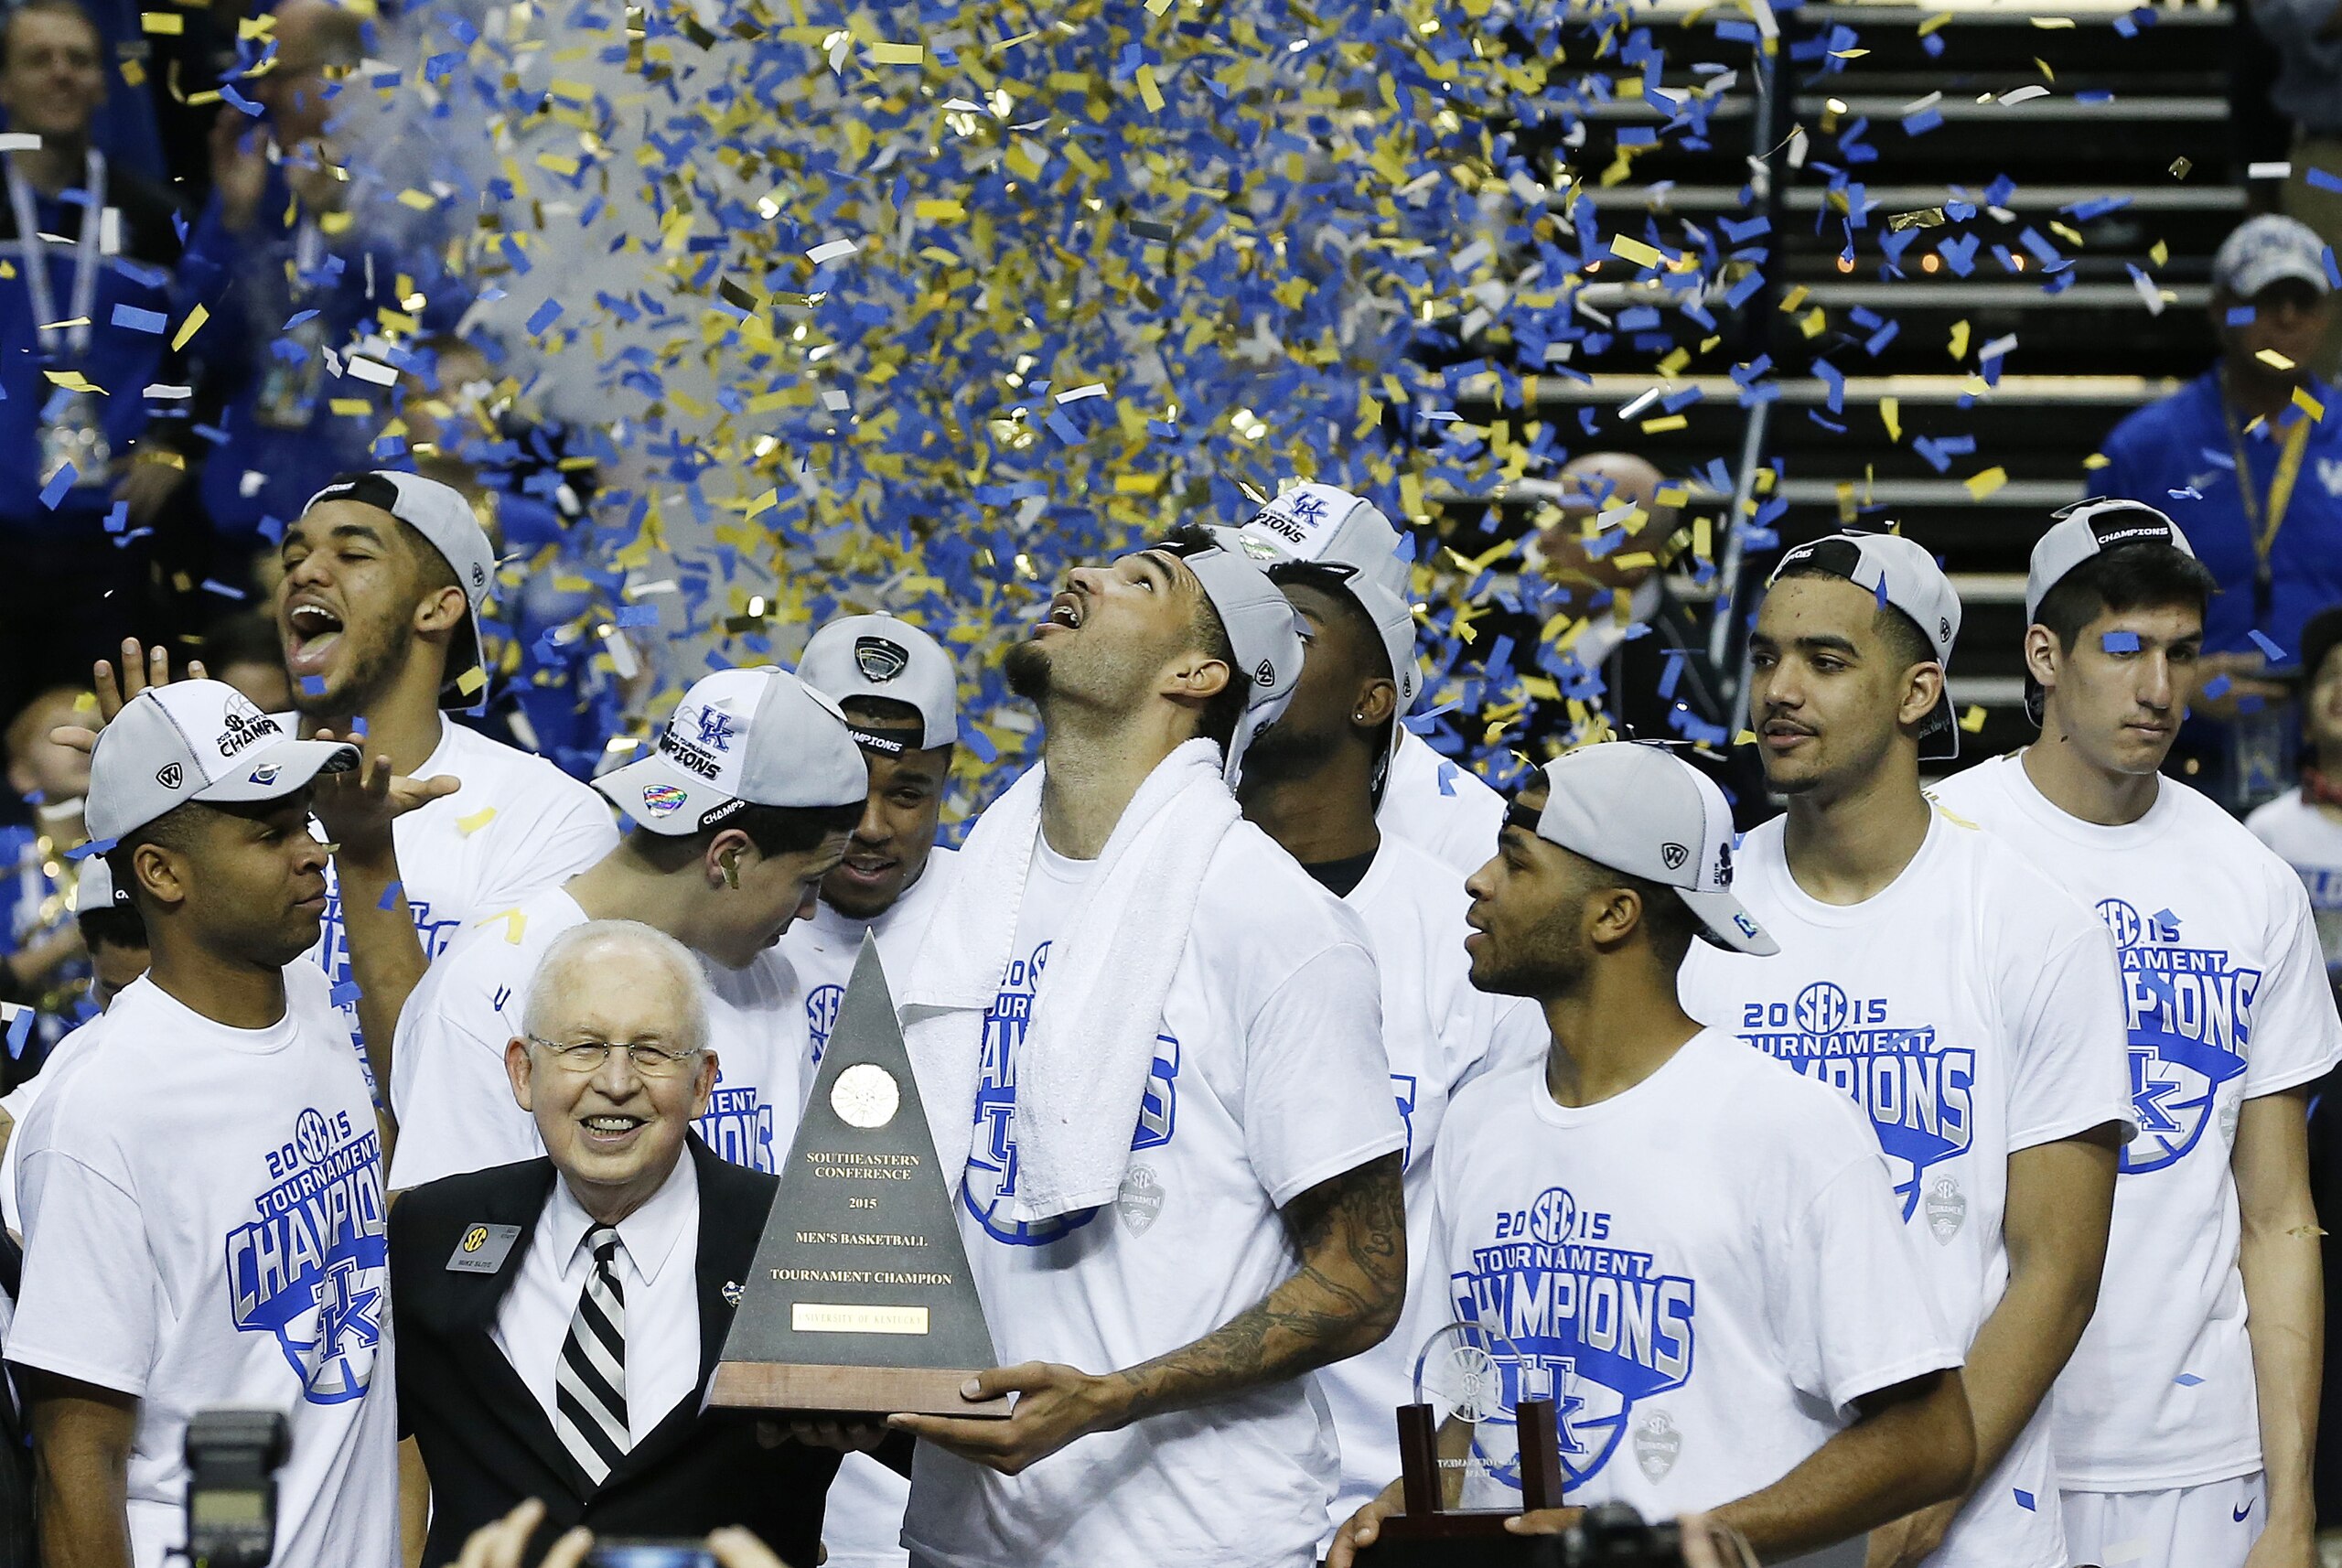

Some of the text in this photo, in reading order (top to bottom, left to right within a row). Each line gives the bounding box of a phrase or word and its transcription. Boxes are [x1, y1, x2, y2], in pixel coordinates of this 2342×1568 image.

[1289, 491, 1329, 528] UK
[1254, 512, 1308, 546] PIONS
[2098, 527, 2168, 544] CHAMPIONS
[696, 704, 735, 753] UK
[703, 799, 746, 825] CHAMPS
[1744, 983, 1888, 1035] 20 SEC 15
[2122, 971, 2260, 1063] PIONS
[1745, 1032, 1933, 1057] URNAMENT
[265, 1109, 352, 1180] 20 SEC 15
[806, 1152, 920, 1166] SOUTHEASTERN
[257, 1133, 381, 1219] TOURNAMENT
[814, 1166, 911, 1180] CONFERENCE
[848, 1197, 878, 1209] 2015
[1495, 1187, 1611, 1245] 20 SEC 15
[795, 1231, 929, 1247] MEN'S BASKETBALL
[770, 1268, 952, 1285] TOURNAMENT CHAMPION
[1475, 1245, 1651, 1279] TOURNAMENT
[798, 1313, 921, 1326] UNIVERSITY OF KENTUCKY
